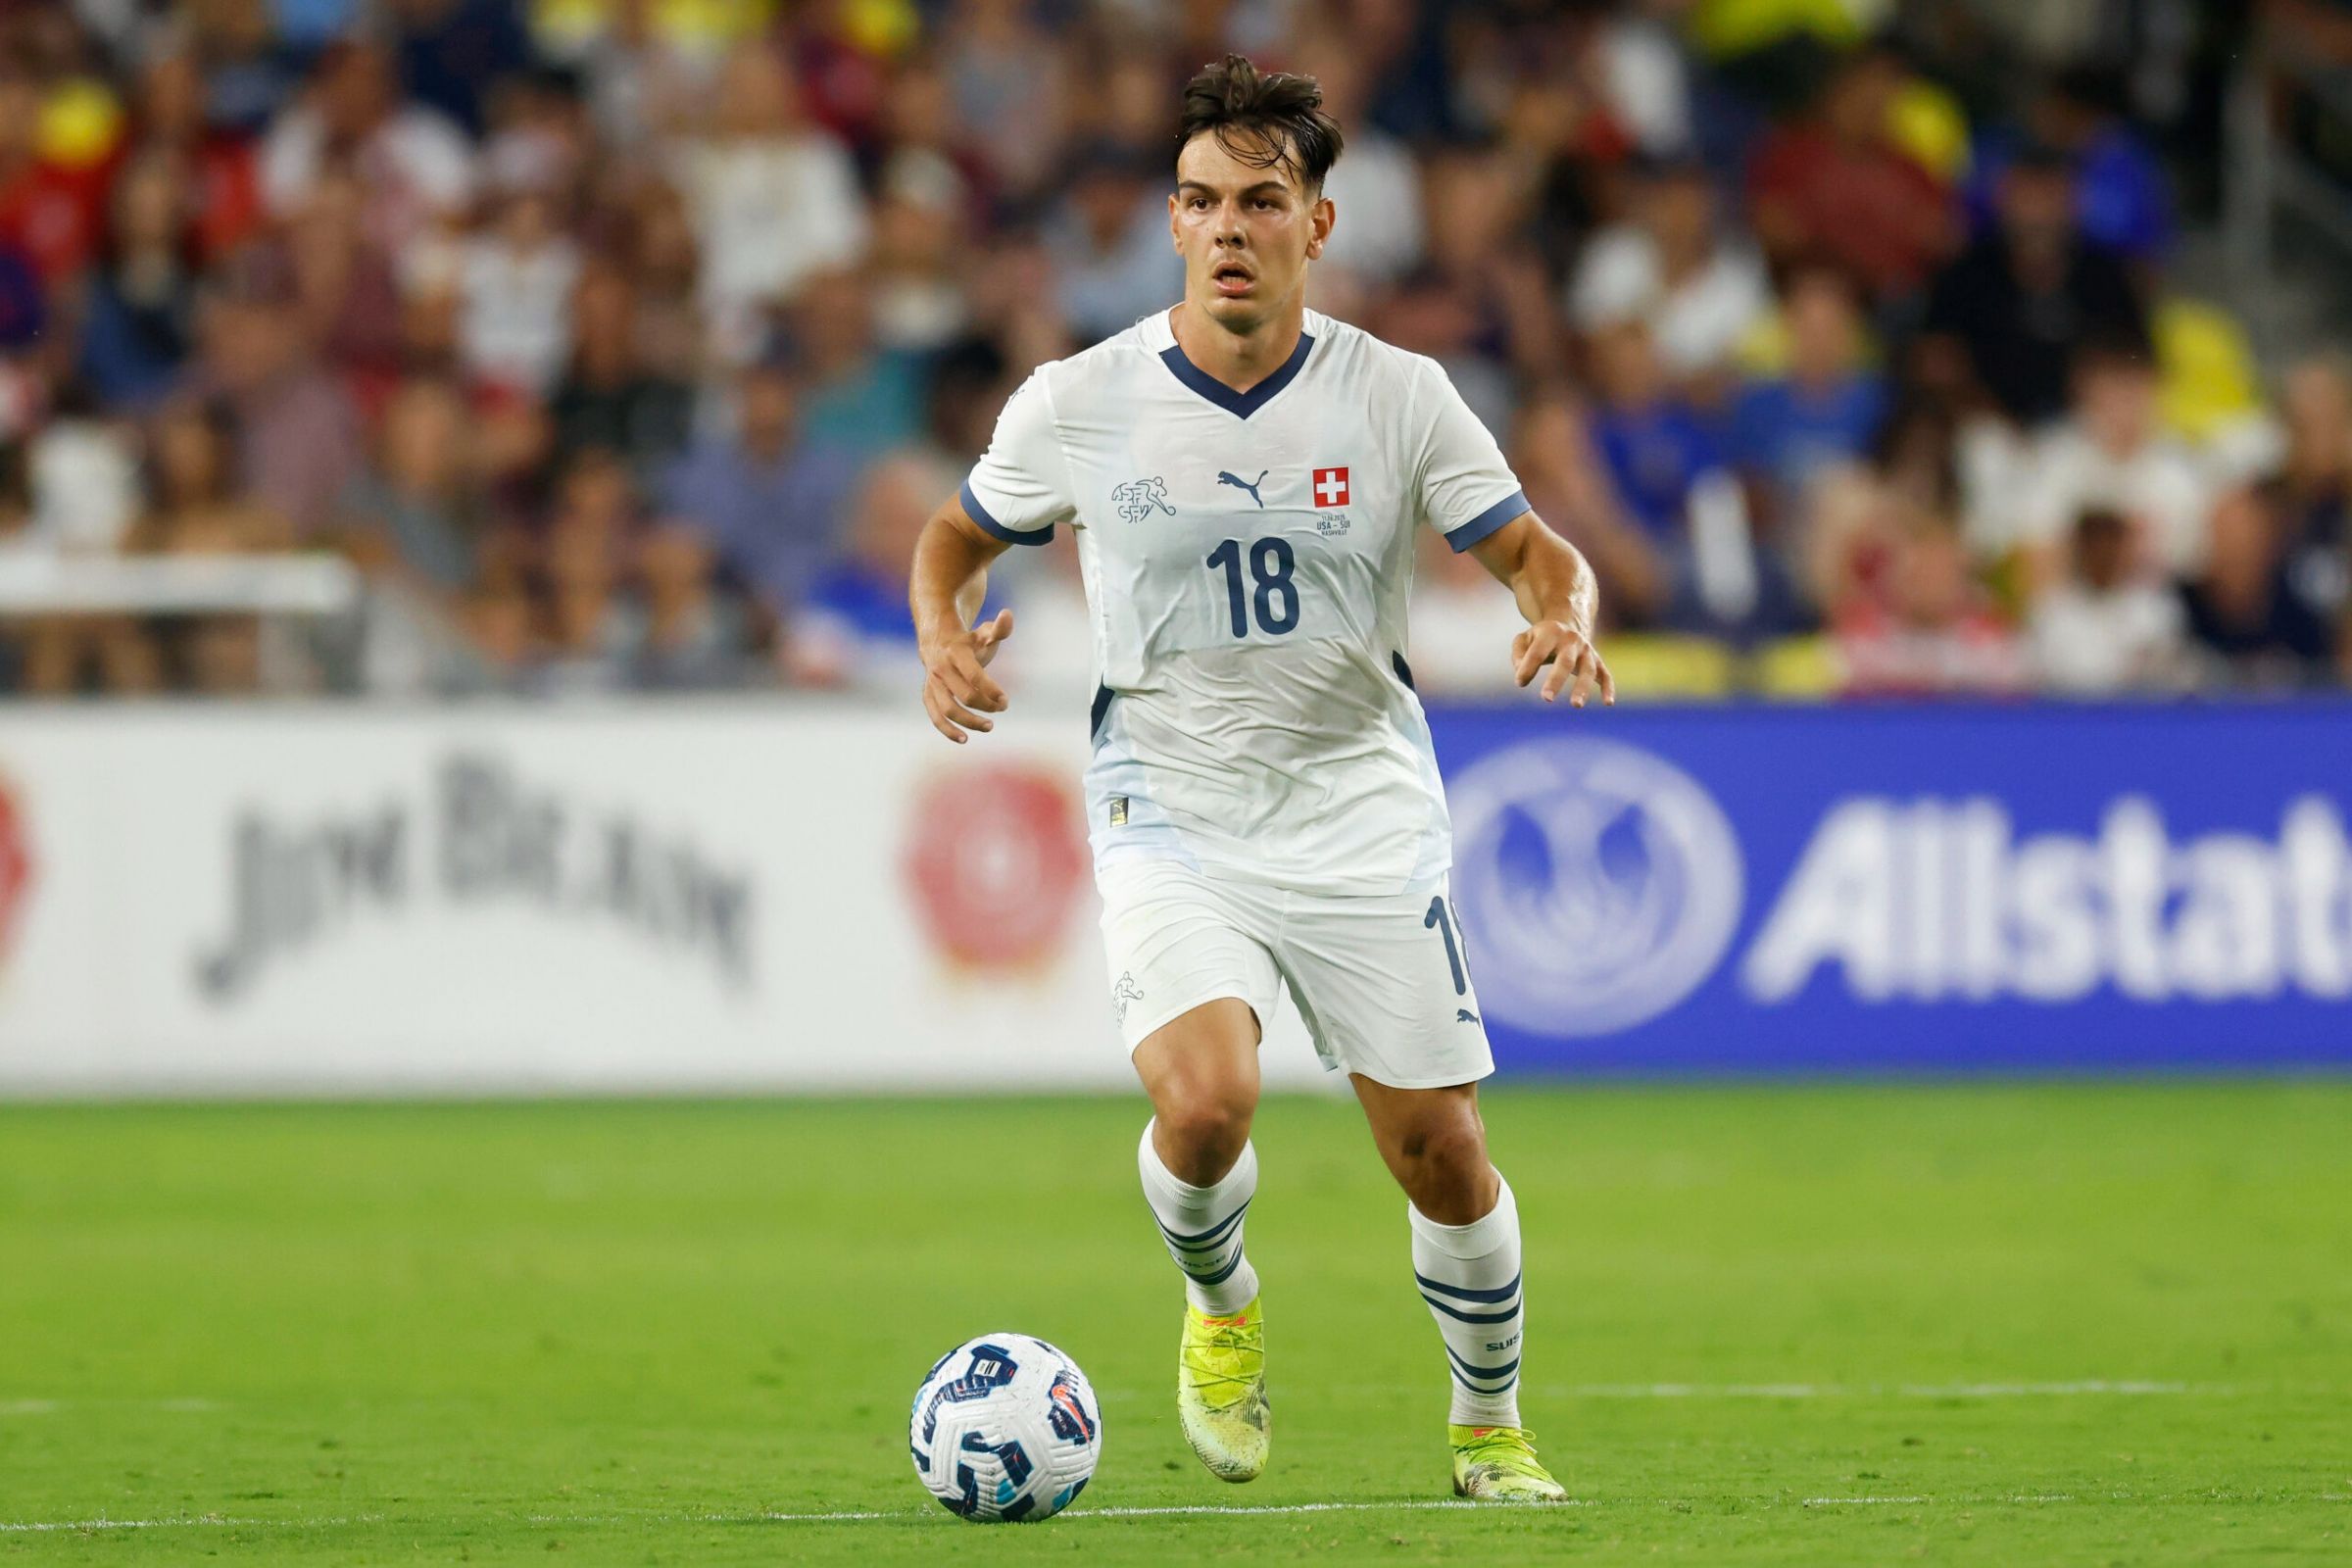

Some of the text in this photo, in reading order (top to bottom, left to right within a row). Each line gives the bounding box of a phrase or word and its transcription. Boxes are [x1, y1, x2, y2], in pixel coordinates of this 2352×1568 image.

[1316, 521, 1332, 530] USA
[1340, 520, 1350, 529] SUI
[1206, 536, 1300, 638] 18
[1424, 896, 1472, 996] 1
[1486, 1326, 1523, 1351] SUIS
